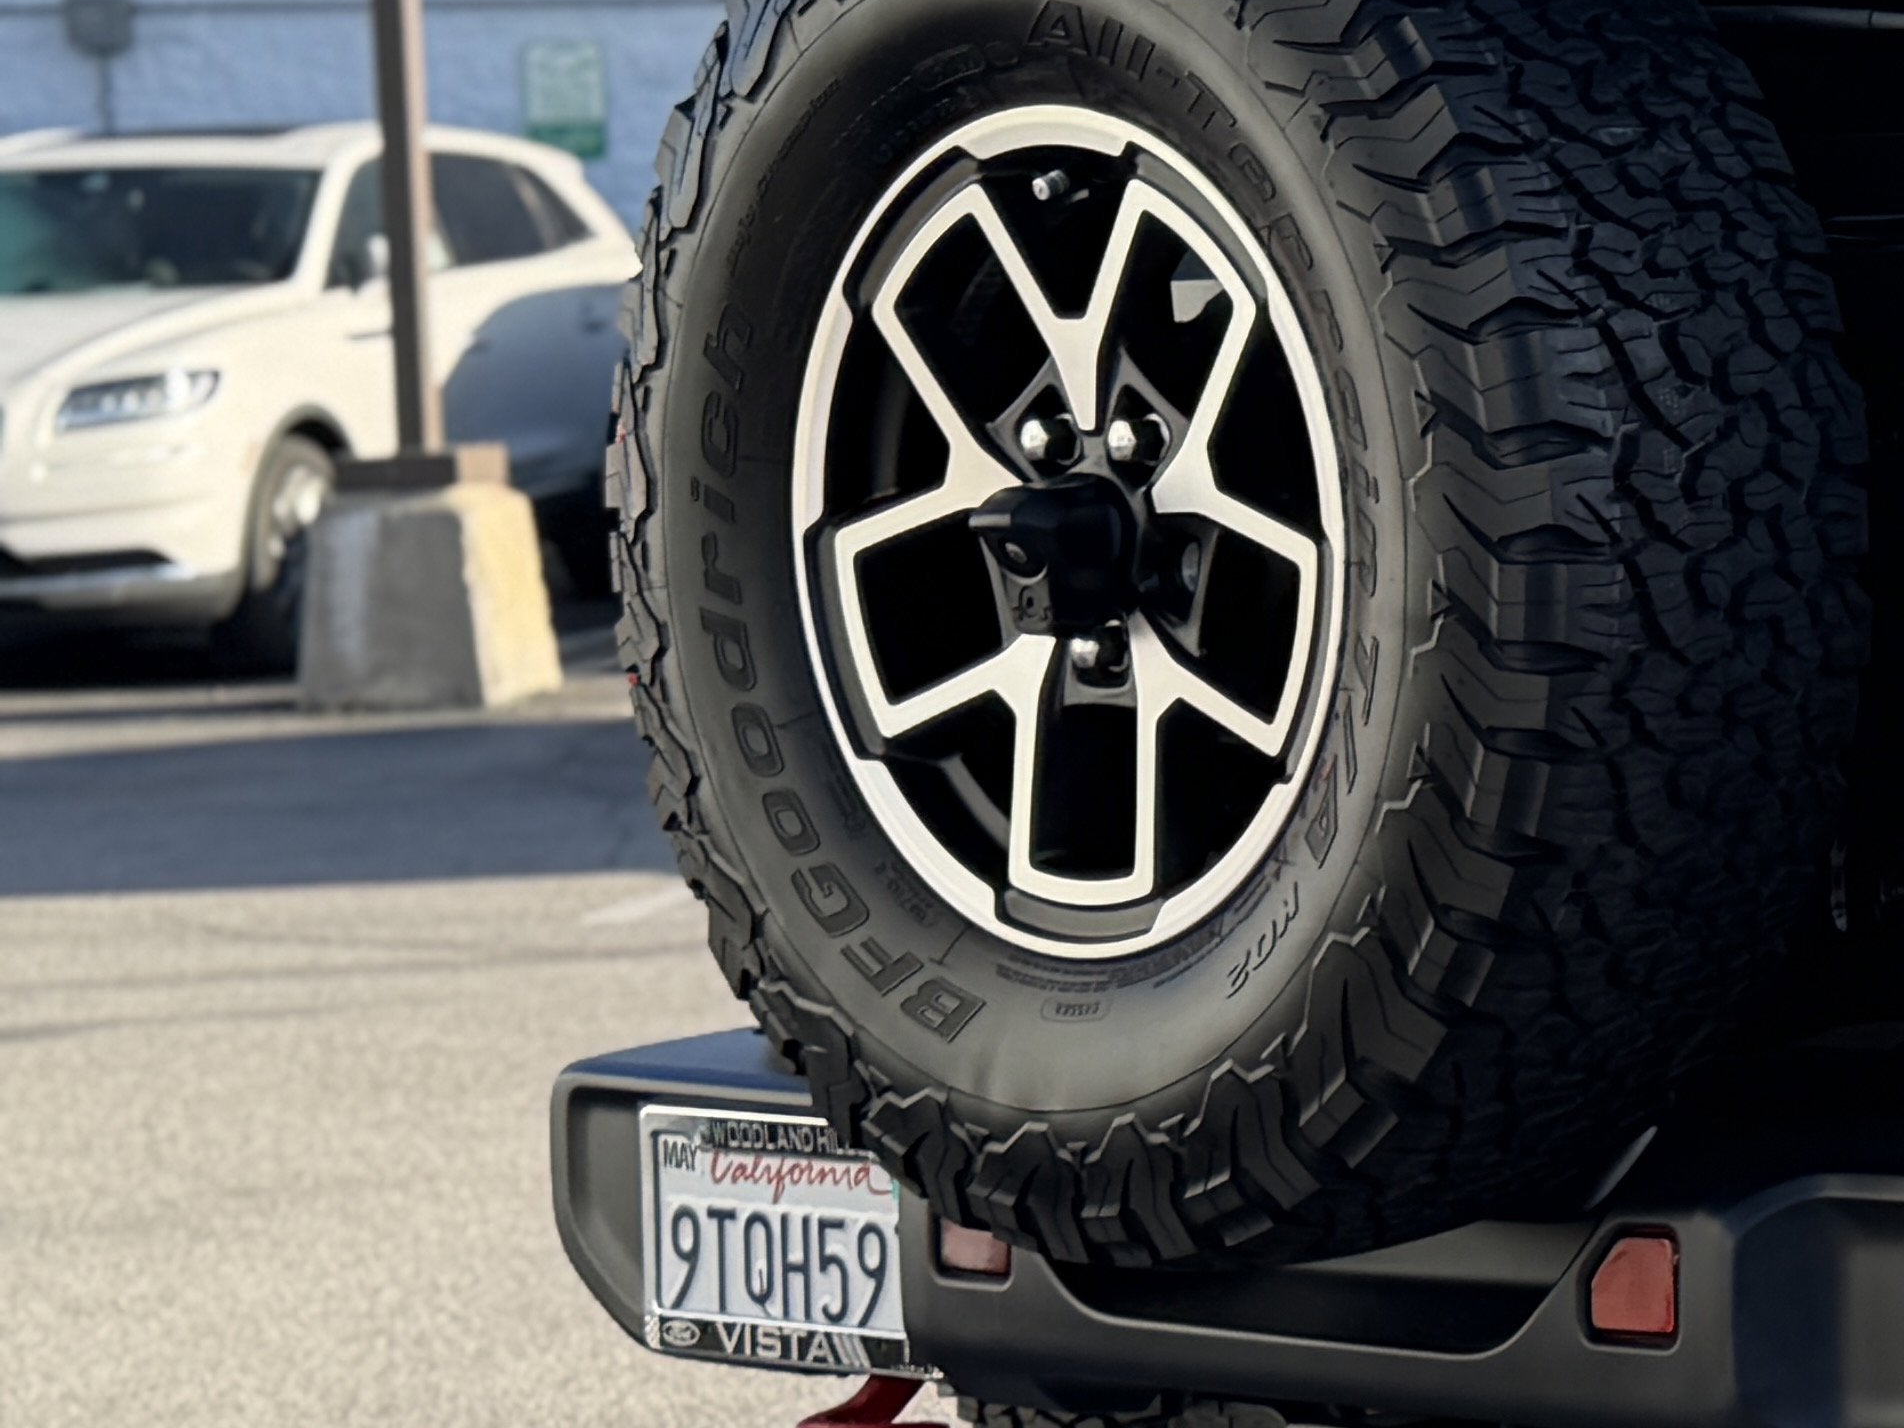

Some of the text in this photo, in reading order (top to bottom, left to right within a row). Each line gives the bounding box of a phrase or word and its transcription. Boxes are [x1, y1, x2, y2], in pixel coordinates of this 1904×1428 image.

[690, 302, 987, 1044] BFGoodrich
[663, 1138, 698, 1172] MAY
[712, 1121, 814, 1153] WOODLAND
[711, 1149, 892, 1204] California
[669, 1204, 898, 1329] 9TQH59
[715, 1322, 835, 1365] VISTA
